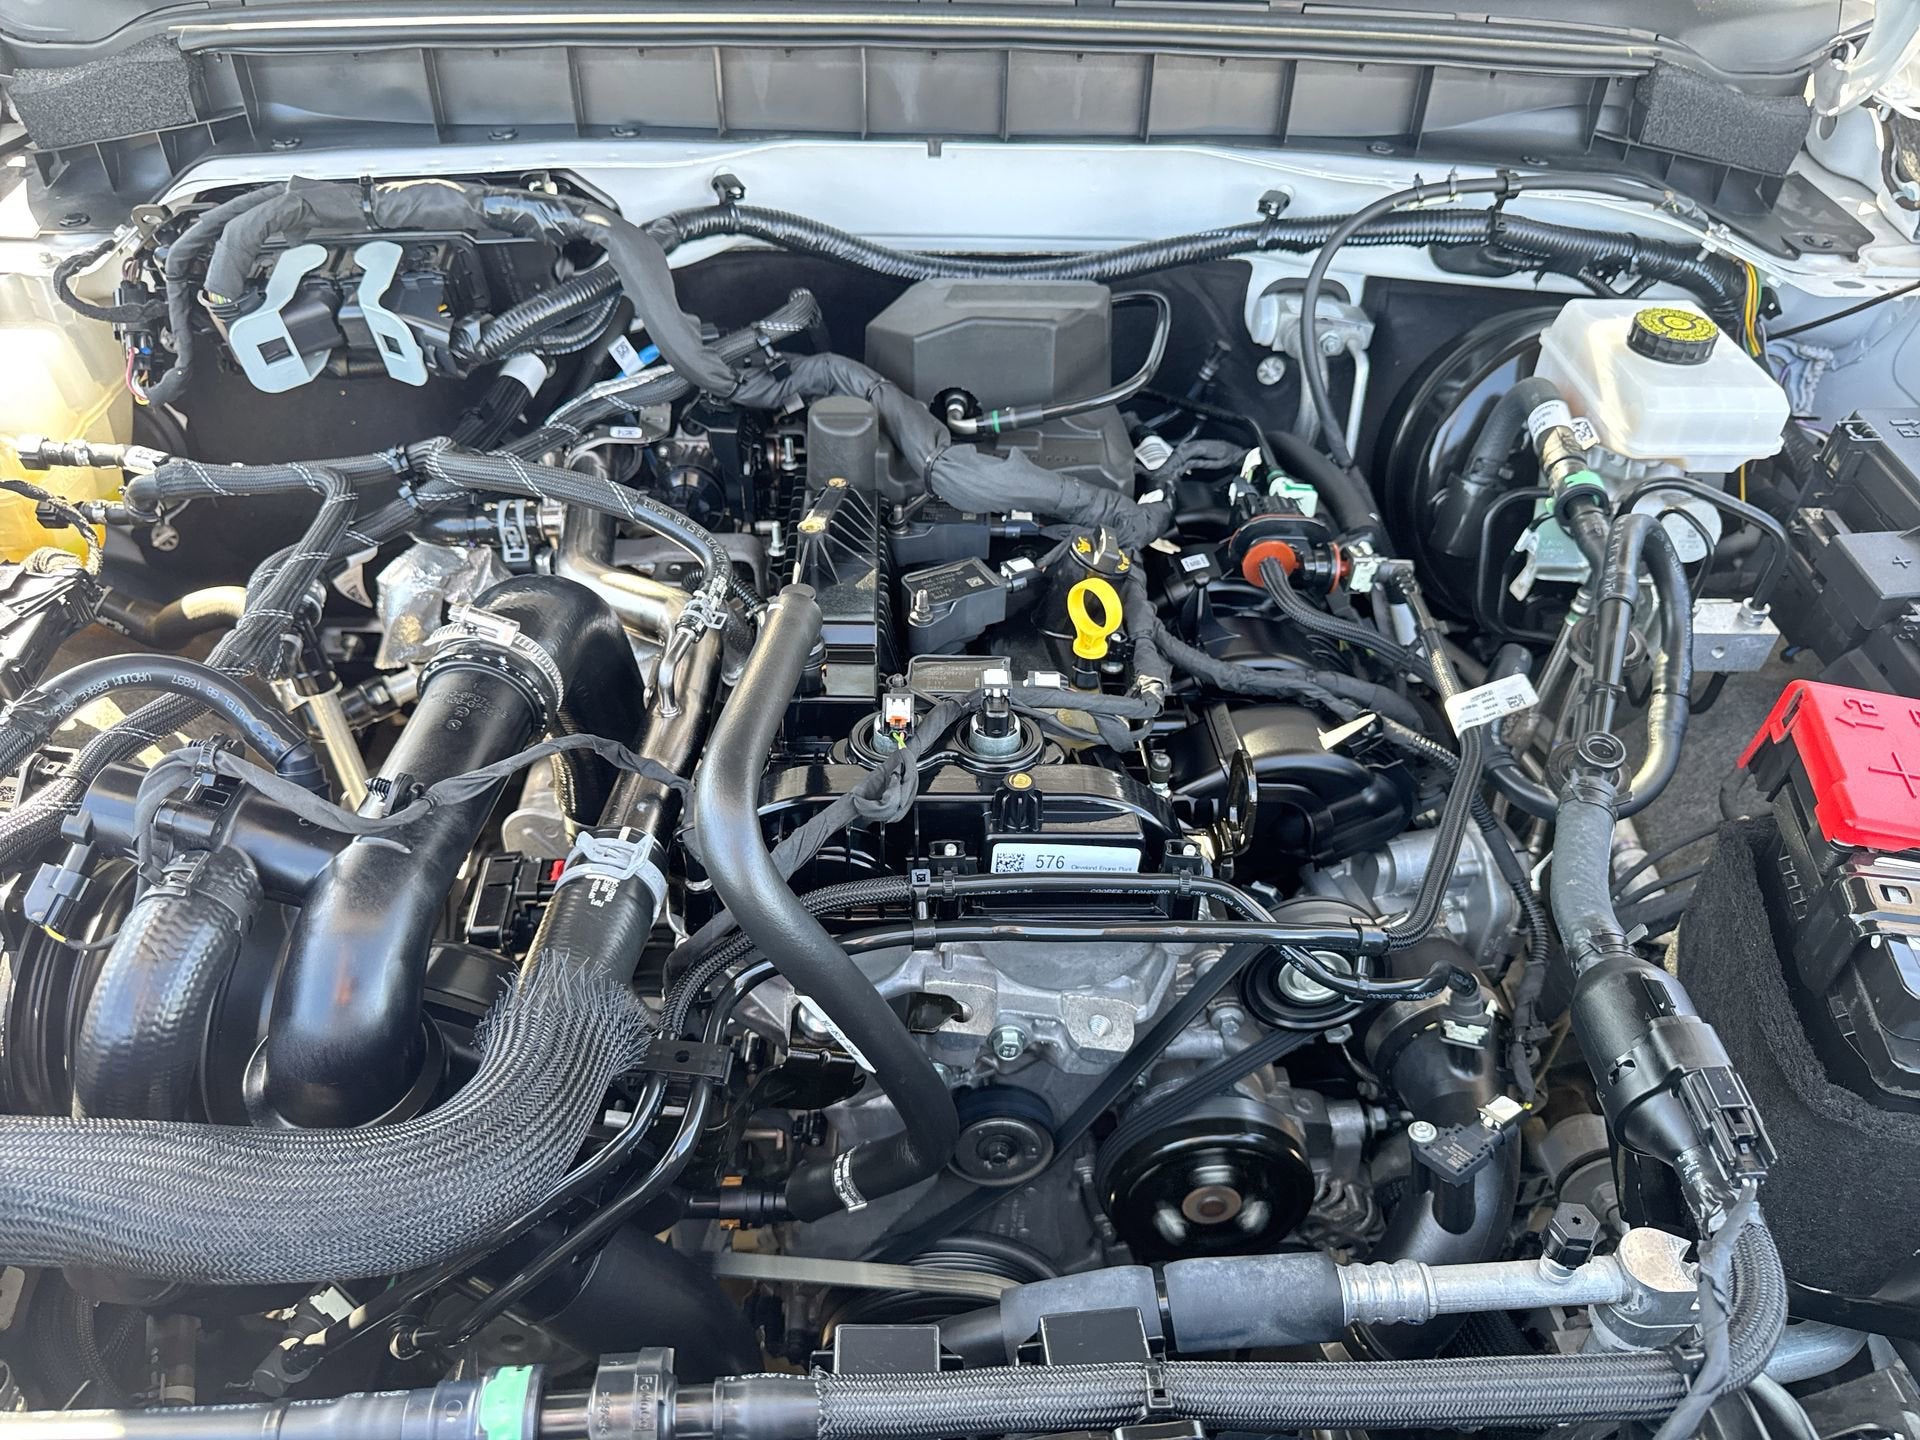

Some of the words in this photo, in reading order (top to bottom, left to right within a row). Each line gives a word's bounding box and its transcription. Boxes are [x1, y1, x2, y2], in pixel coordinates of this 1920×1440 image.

[111, 671, 152, 687] VACUUM
[78, 679, 110, 703] BRAKE
[1035, 854, 1066, 870] 576
[1070, 864, 1098, 872] Cleveland
[1098, 865, 1117, 873] Engine
